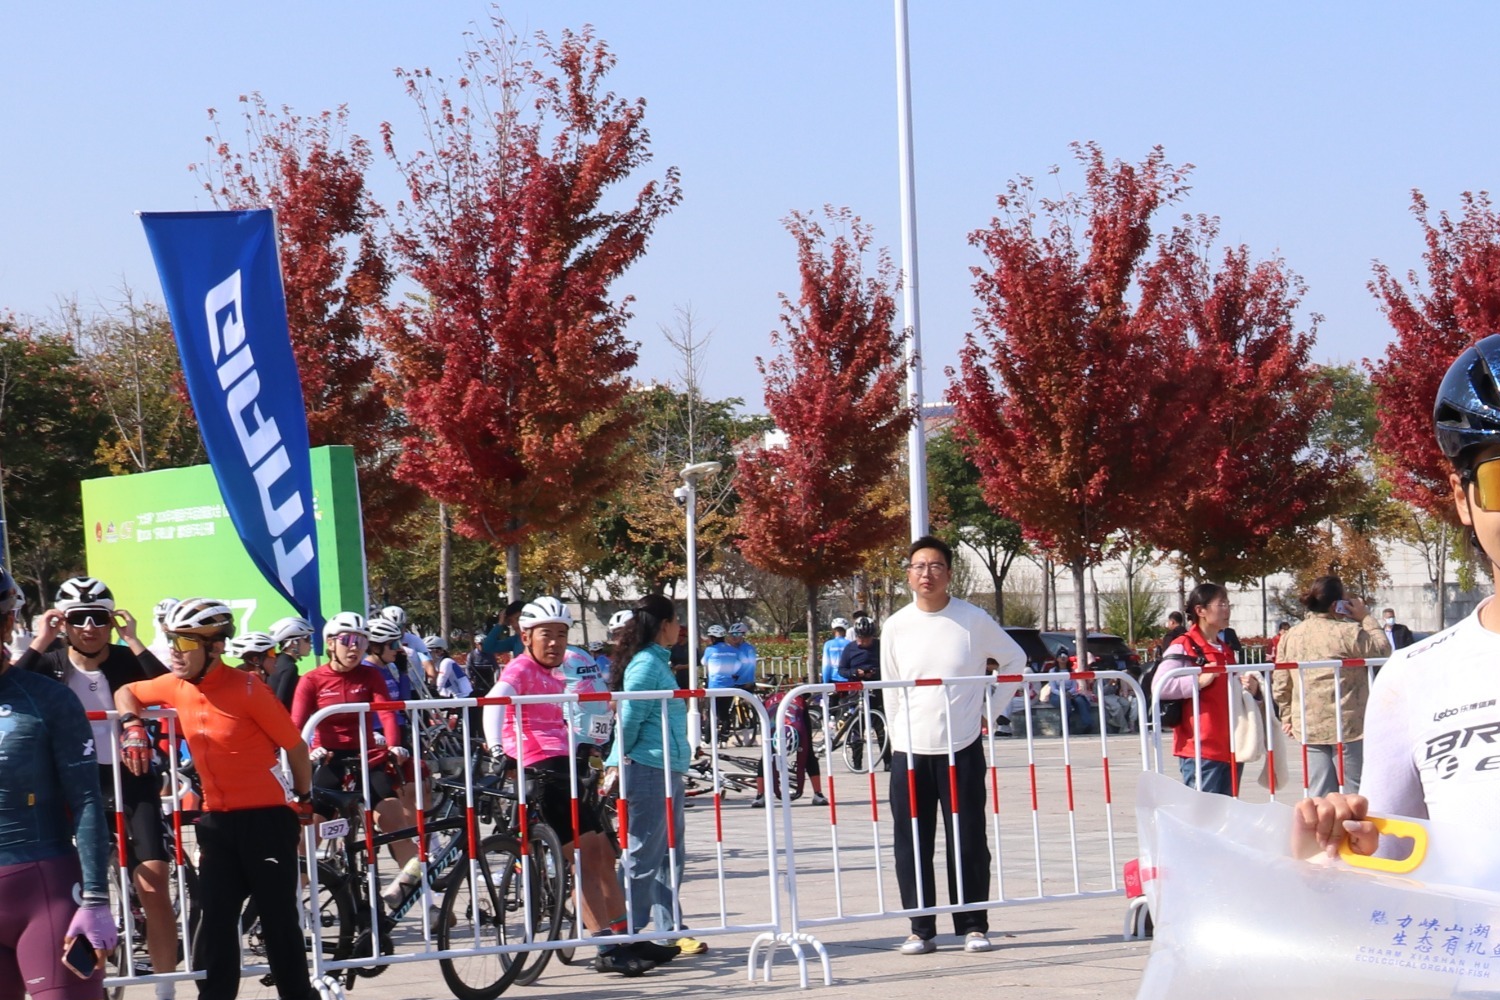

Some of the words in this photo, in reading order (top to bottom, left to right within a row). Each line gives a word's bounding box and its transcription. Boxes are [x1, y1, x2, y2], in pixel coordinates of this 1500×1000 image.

[327, 824, 345, 835] 297
[1369, 909, 1491, 938] 魅力峡山湖
[1355, 954, 1417, 969] ECOLOGICAL
[1420, 963, 1465, 976] ORGANIC
[1468, 969, 1491, 978] FISH
[1359, 946, 1403, 957] CHARM
[1409, 953, 1466, 966] XIASHAN
